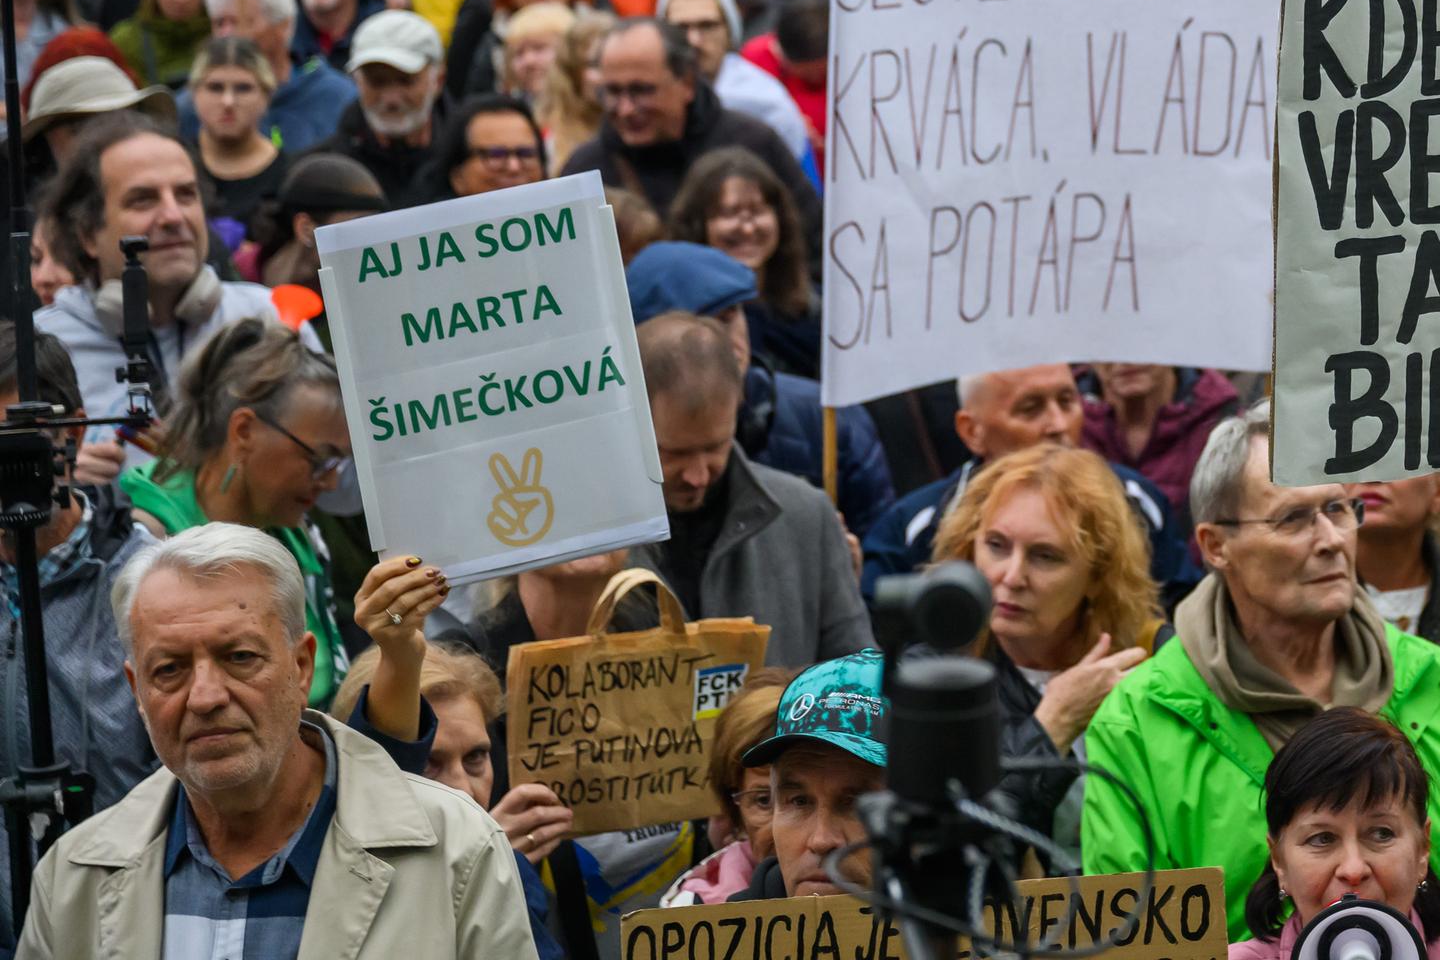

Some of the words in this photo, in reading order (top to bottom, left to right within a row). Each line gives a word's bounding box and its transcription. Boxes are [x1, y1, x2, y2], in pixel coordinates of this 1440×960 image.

[1086, 17, 1270, 161] VLÁDA
[357, 240, 403, 283] AJ
[416, 230, 466, 272] JA
[475, 206, 577, 258] SOM
[829, 217, 892, 351] SA
[926, 178, 1140, 331] POTÁPA
[400, 284, 563, 347] MARTA
[368, 346, 626, 442] ŠIMEČKOVÁ
[528, 653, 716, 704] KOLABORANT
[698, 672, 742, 693] FCK
[528, 702, 600, 739] FICO
[521, 740, 561, 771] JE
[534, 766, 712, 806] ROSTITÚTK
[962, 884, 1211, 953] OVENSKO
